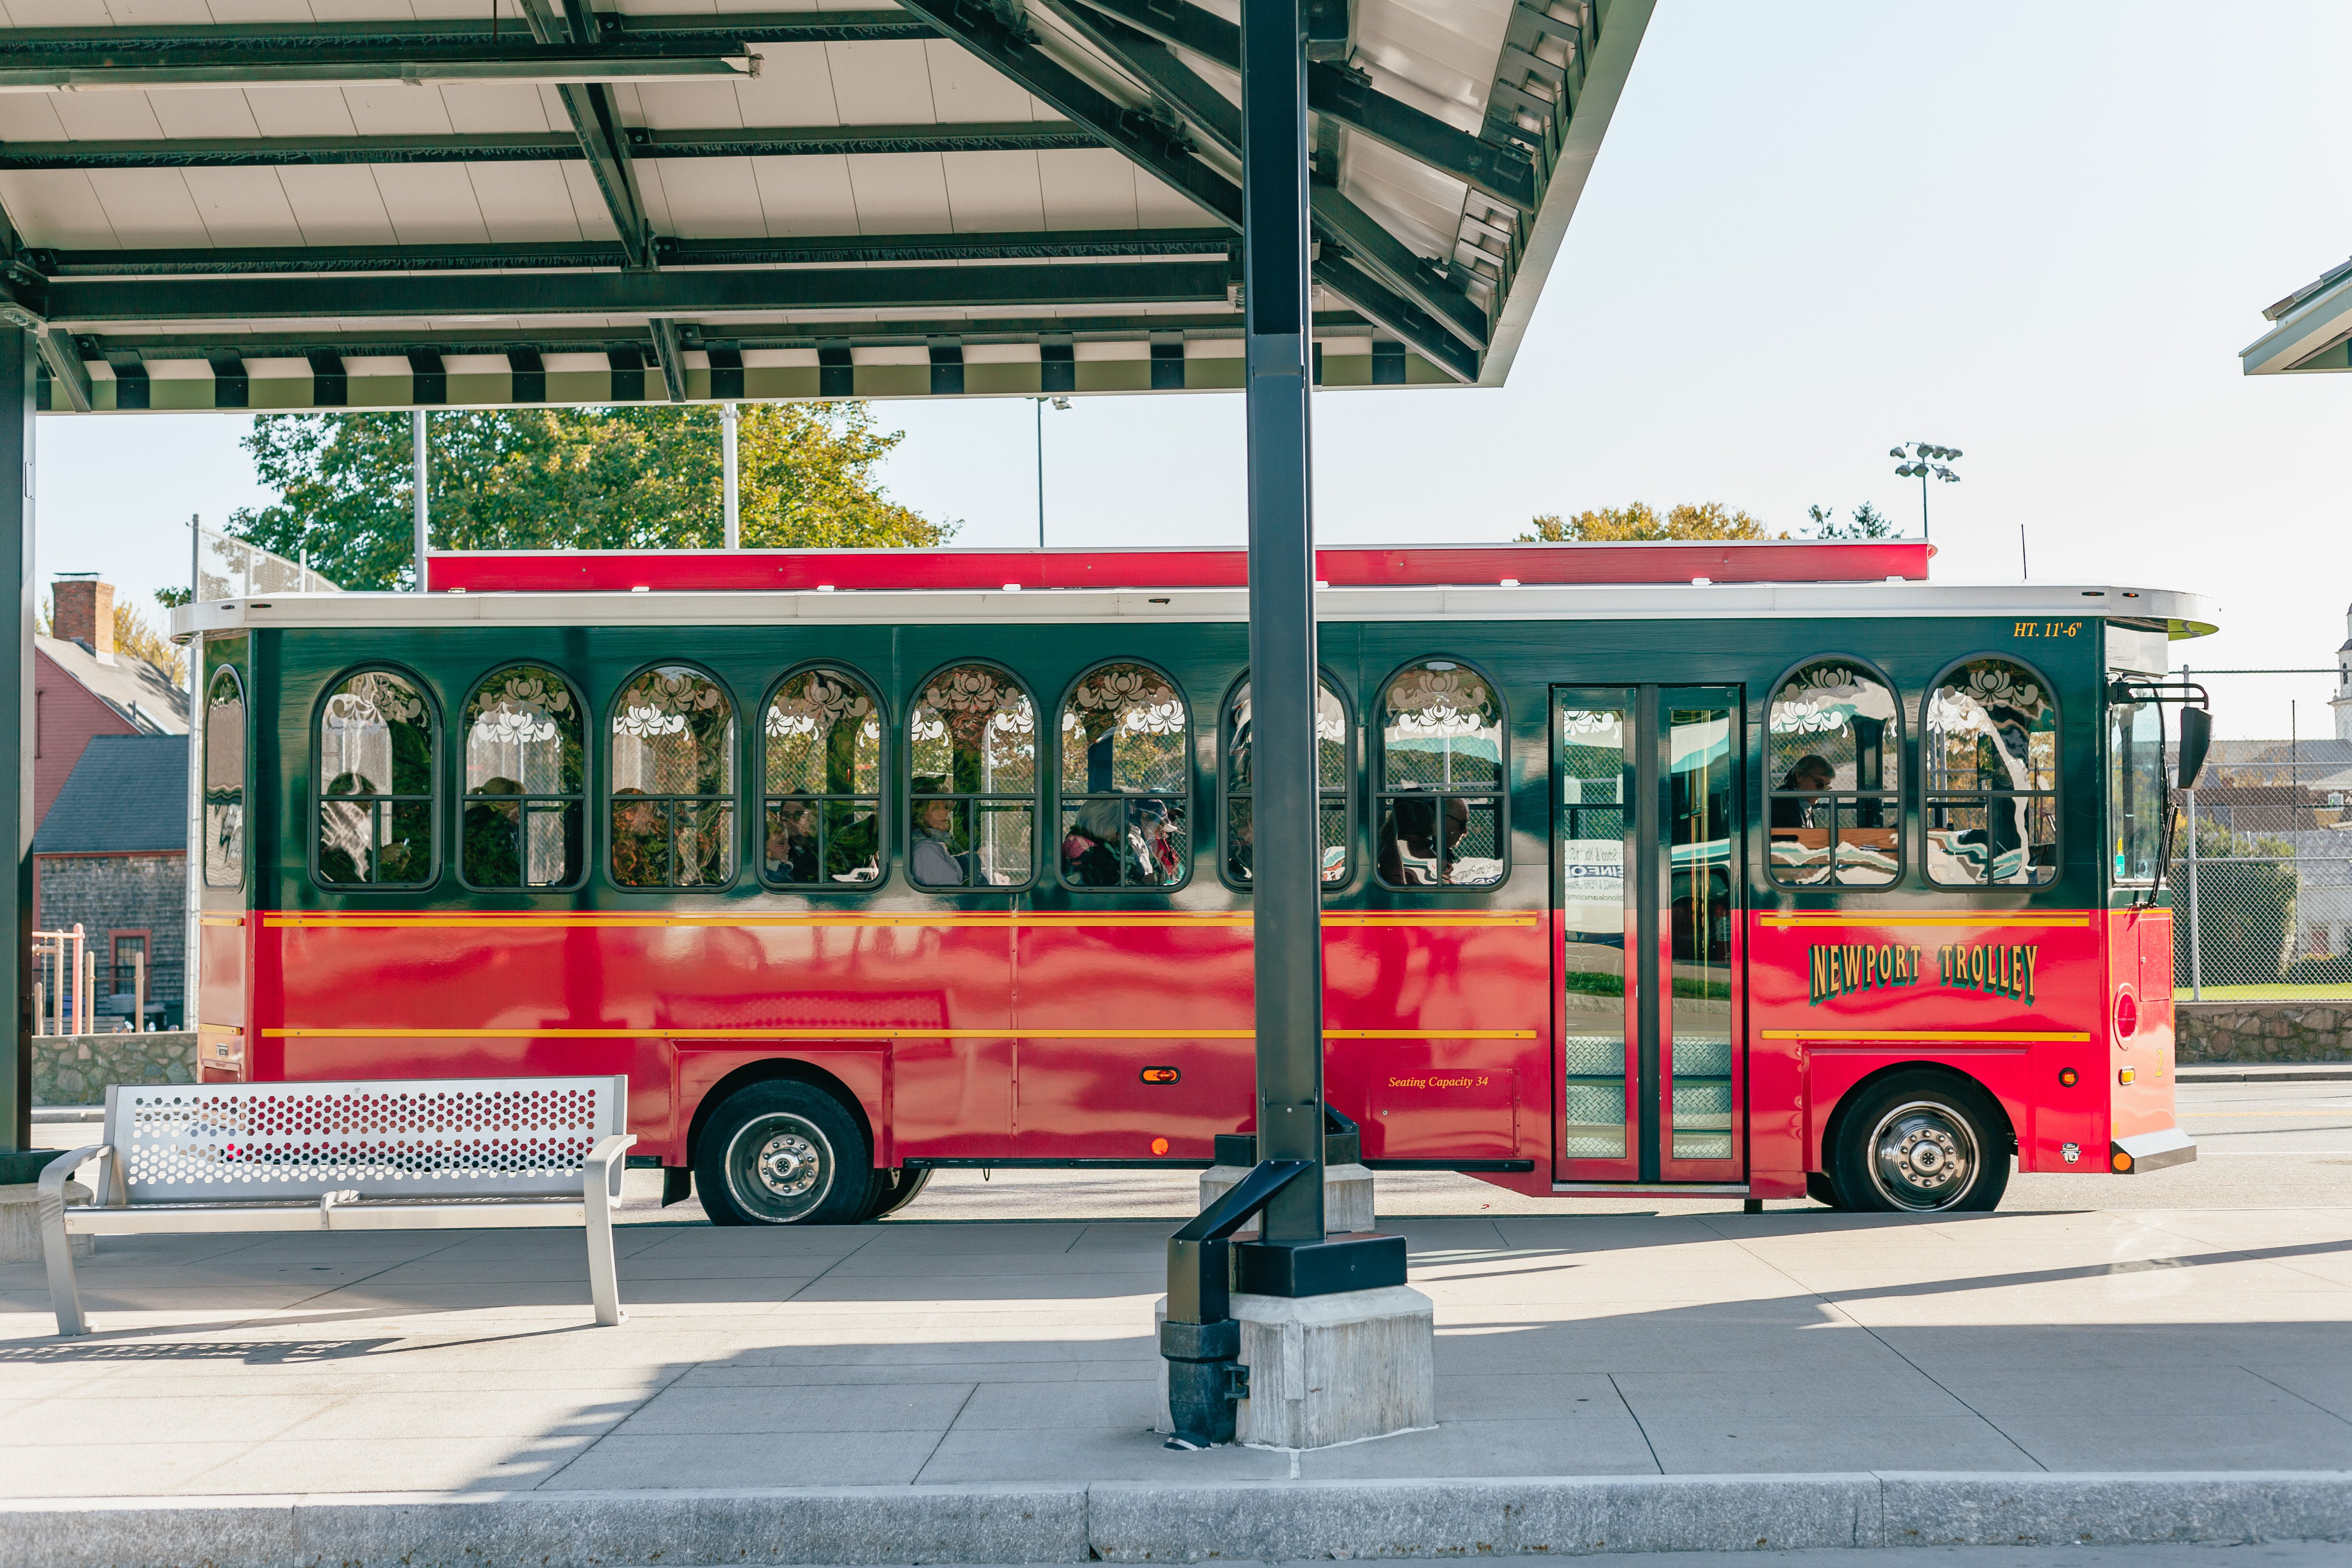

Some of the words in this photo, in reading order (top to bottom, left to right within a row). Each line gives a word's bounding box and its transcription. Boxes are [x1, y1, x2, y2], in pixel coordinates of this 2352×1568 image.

[2013, 622, 2039, 637] HT.
[2044, 622, 2082, 637] 11'-6"
[1809, 942, 1922, 1007] NEWPORT
[1937, 942, 2039, 1007] TROLLEY
[2155, 1048, 2163, 1077] 2
[1388, 1076, 1426, 1089] Seating
[1428, 1076, 1473, 1089] Capacity
[1476, 1076, 1489, 1086] 34
